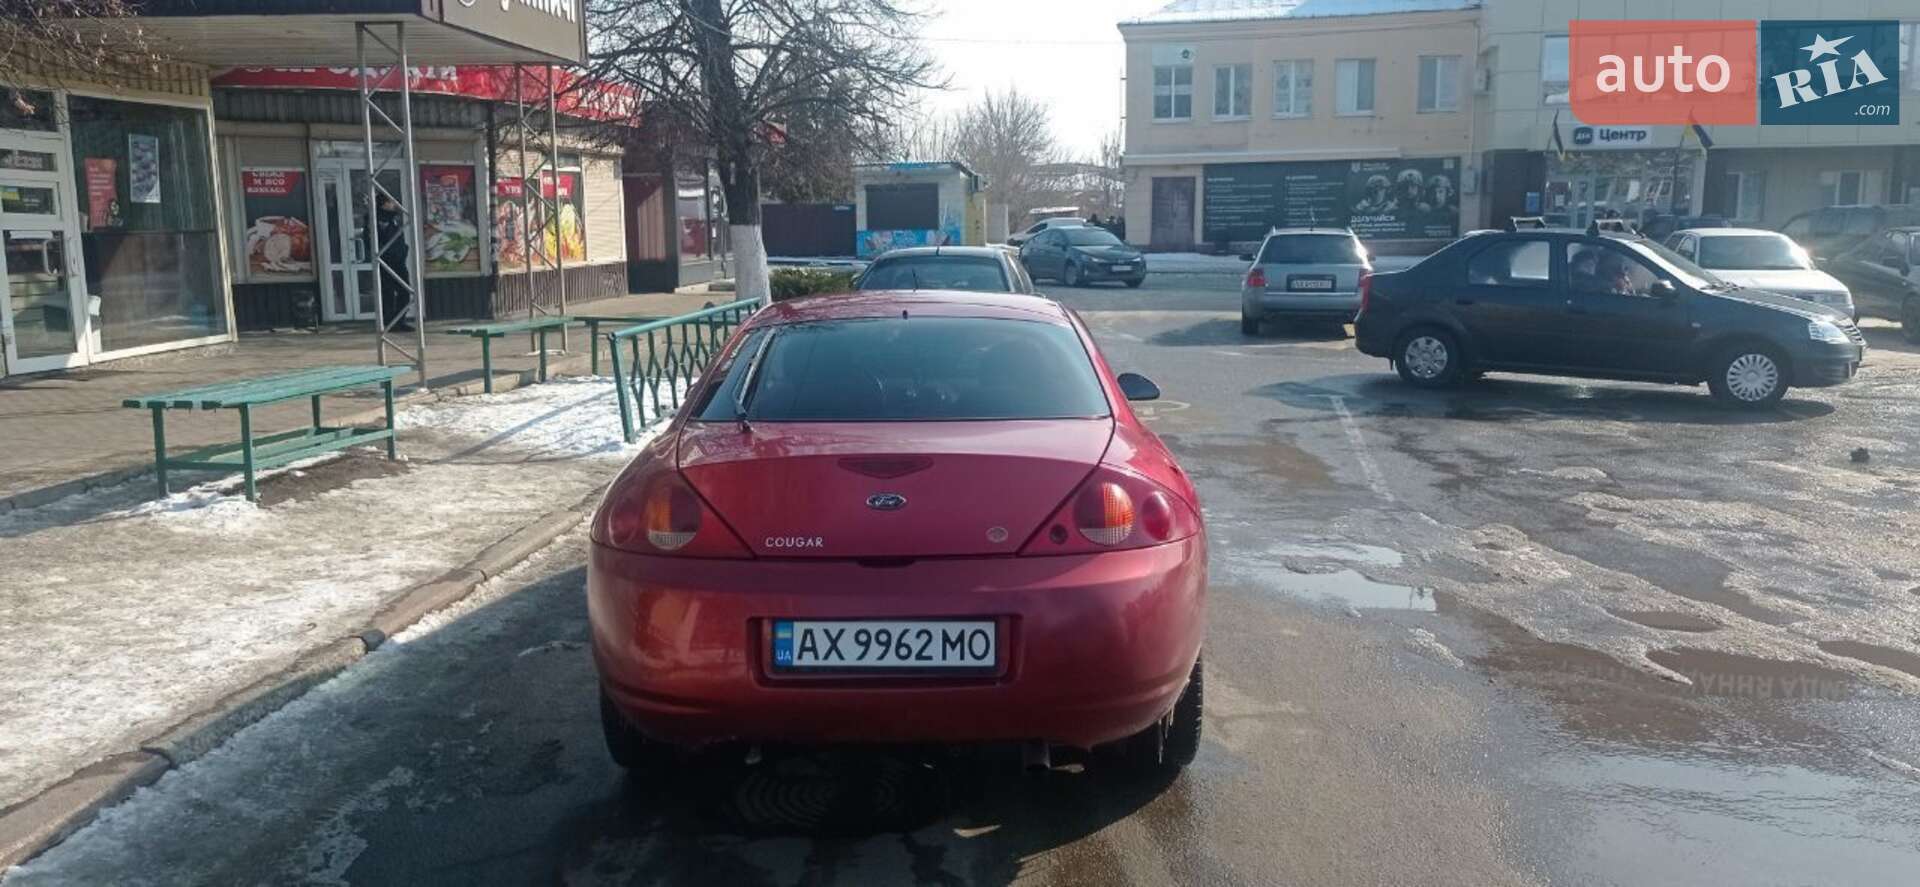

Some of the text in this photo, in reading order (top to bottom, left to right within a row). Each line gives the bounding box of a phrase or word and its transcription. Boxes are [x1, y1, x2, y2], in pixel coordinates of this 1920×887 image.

[1599, 128, 1647, 142] Центр
[765, 536, 824, 548] COUGAR
[796, 628, 991, 661] AX 9962 MO
[776, 649, 792, 661] UA
